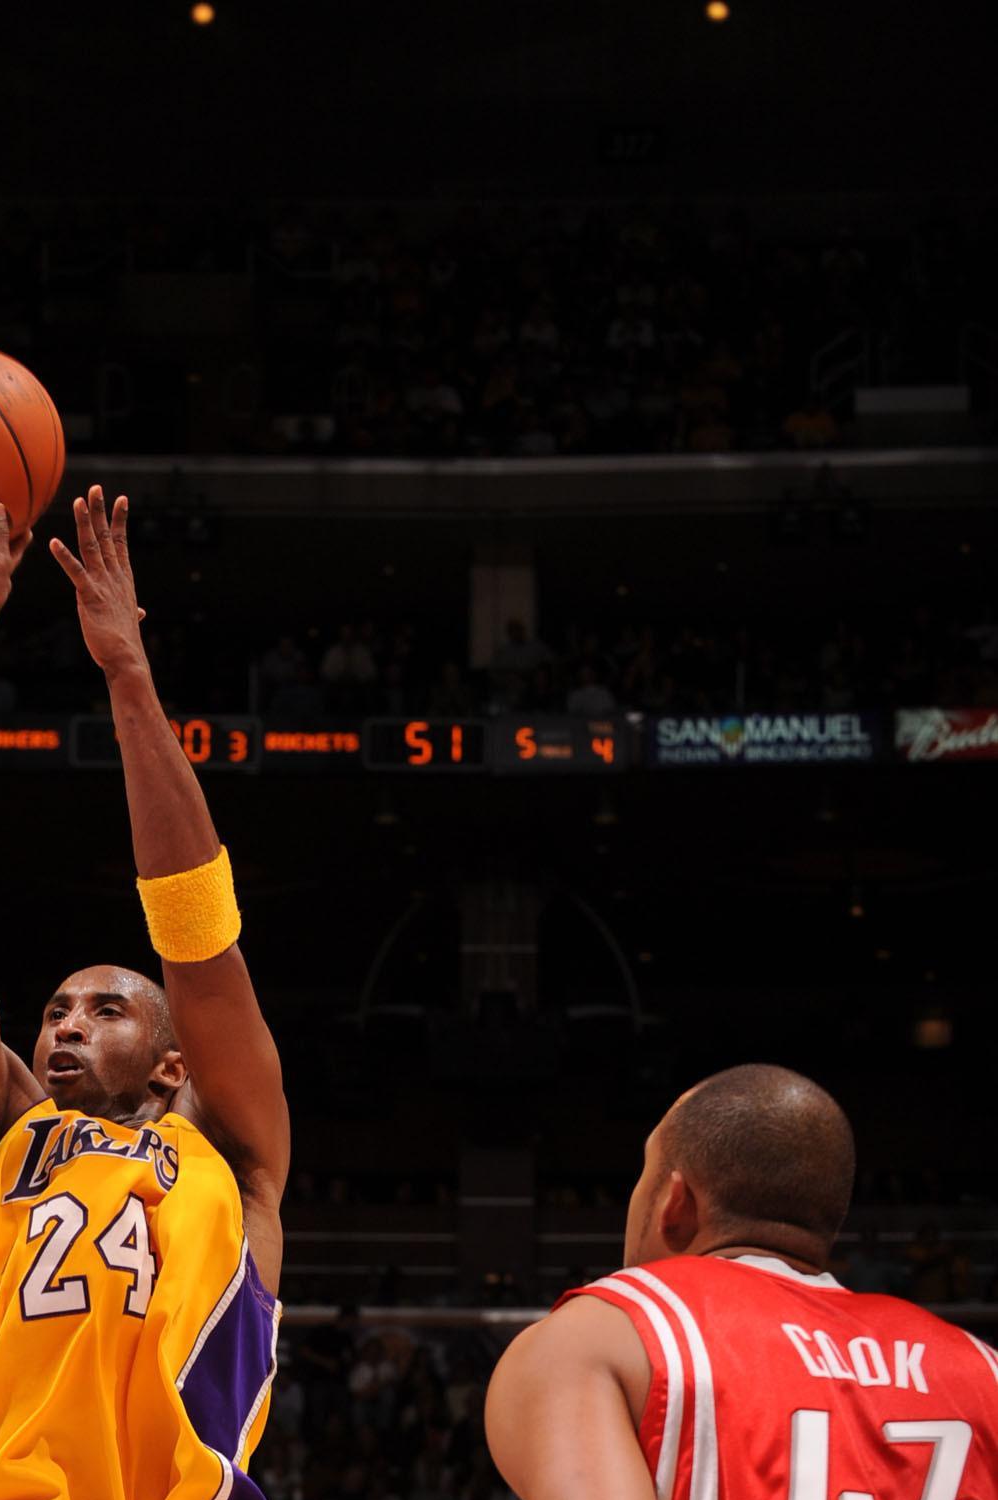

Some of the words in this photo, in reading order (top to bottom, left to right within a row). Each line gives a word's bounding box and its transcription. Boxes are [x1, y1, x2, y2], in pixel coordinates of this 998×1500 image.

[404, 721, 463, 766] 51
[656, 716, 722, 746] SAN
[743, 714, 869, 742] MANUEL
[1, 1115, 179, 1206] LAKERS
[19, 1190, 159, 1322] 24
